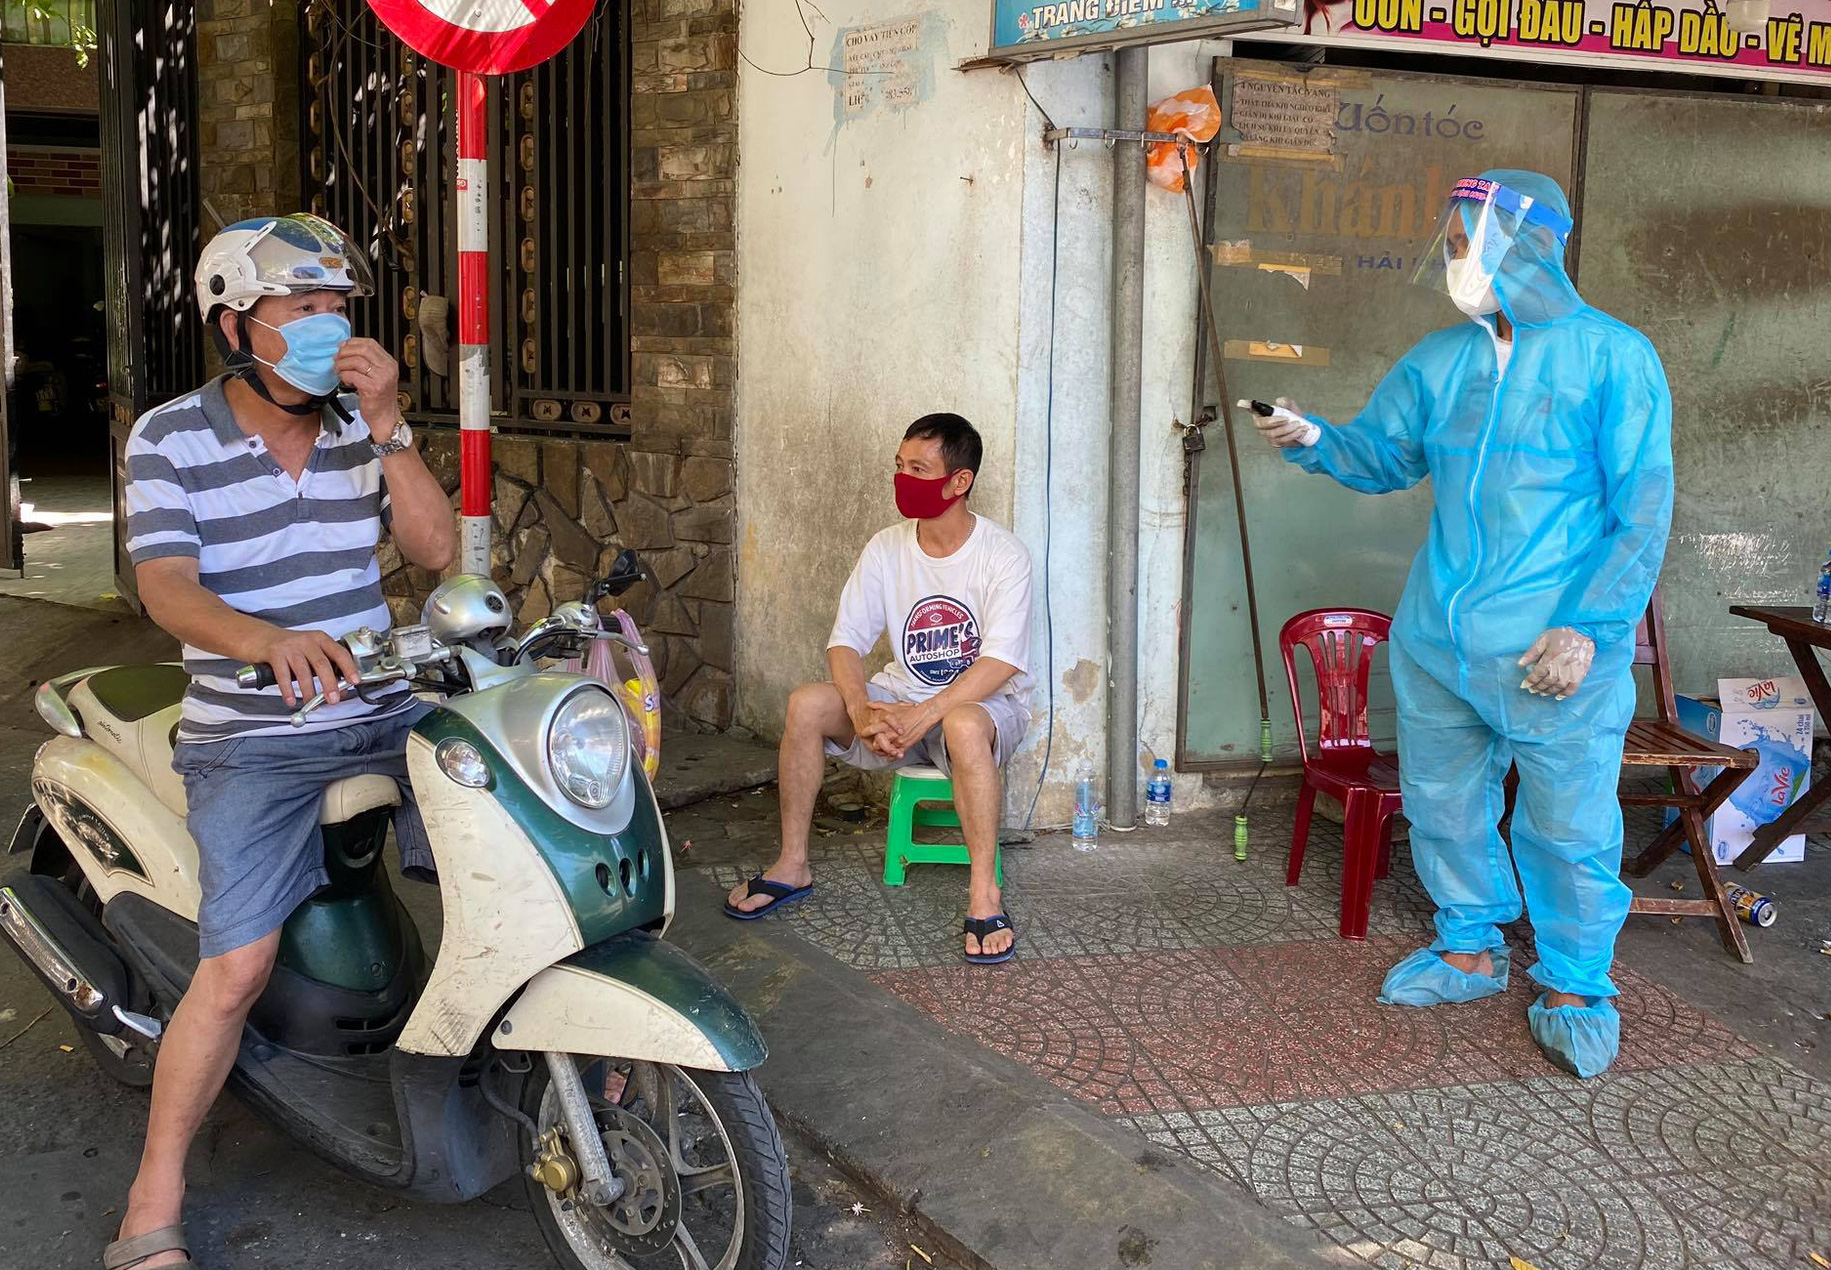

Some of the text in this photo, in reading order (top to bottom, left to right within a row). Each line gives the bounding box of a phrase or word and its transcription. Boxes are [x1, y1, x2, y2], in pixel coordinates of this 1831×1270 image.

[1032, 0, 1099, 30] TRANG
[1611, 0, 1671, 51] HẤP
[1679, 0, 1740, 58] DẦU
[1766, 12, 1803, 64] VẼ
[1335, 94, 1484, 140] Uốn tóc
[1357, 251, 1403, 269] HẢI
[907, 620, 974, 655] PRIME'S
[909, 649, 960, 662] AUTOSHOP
